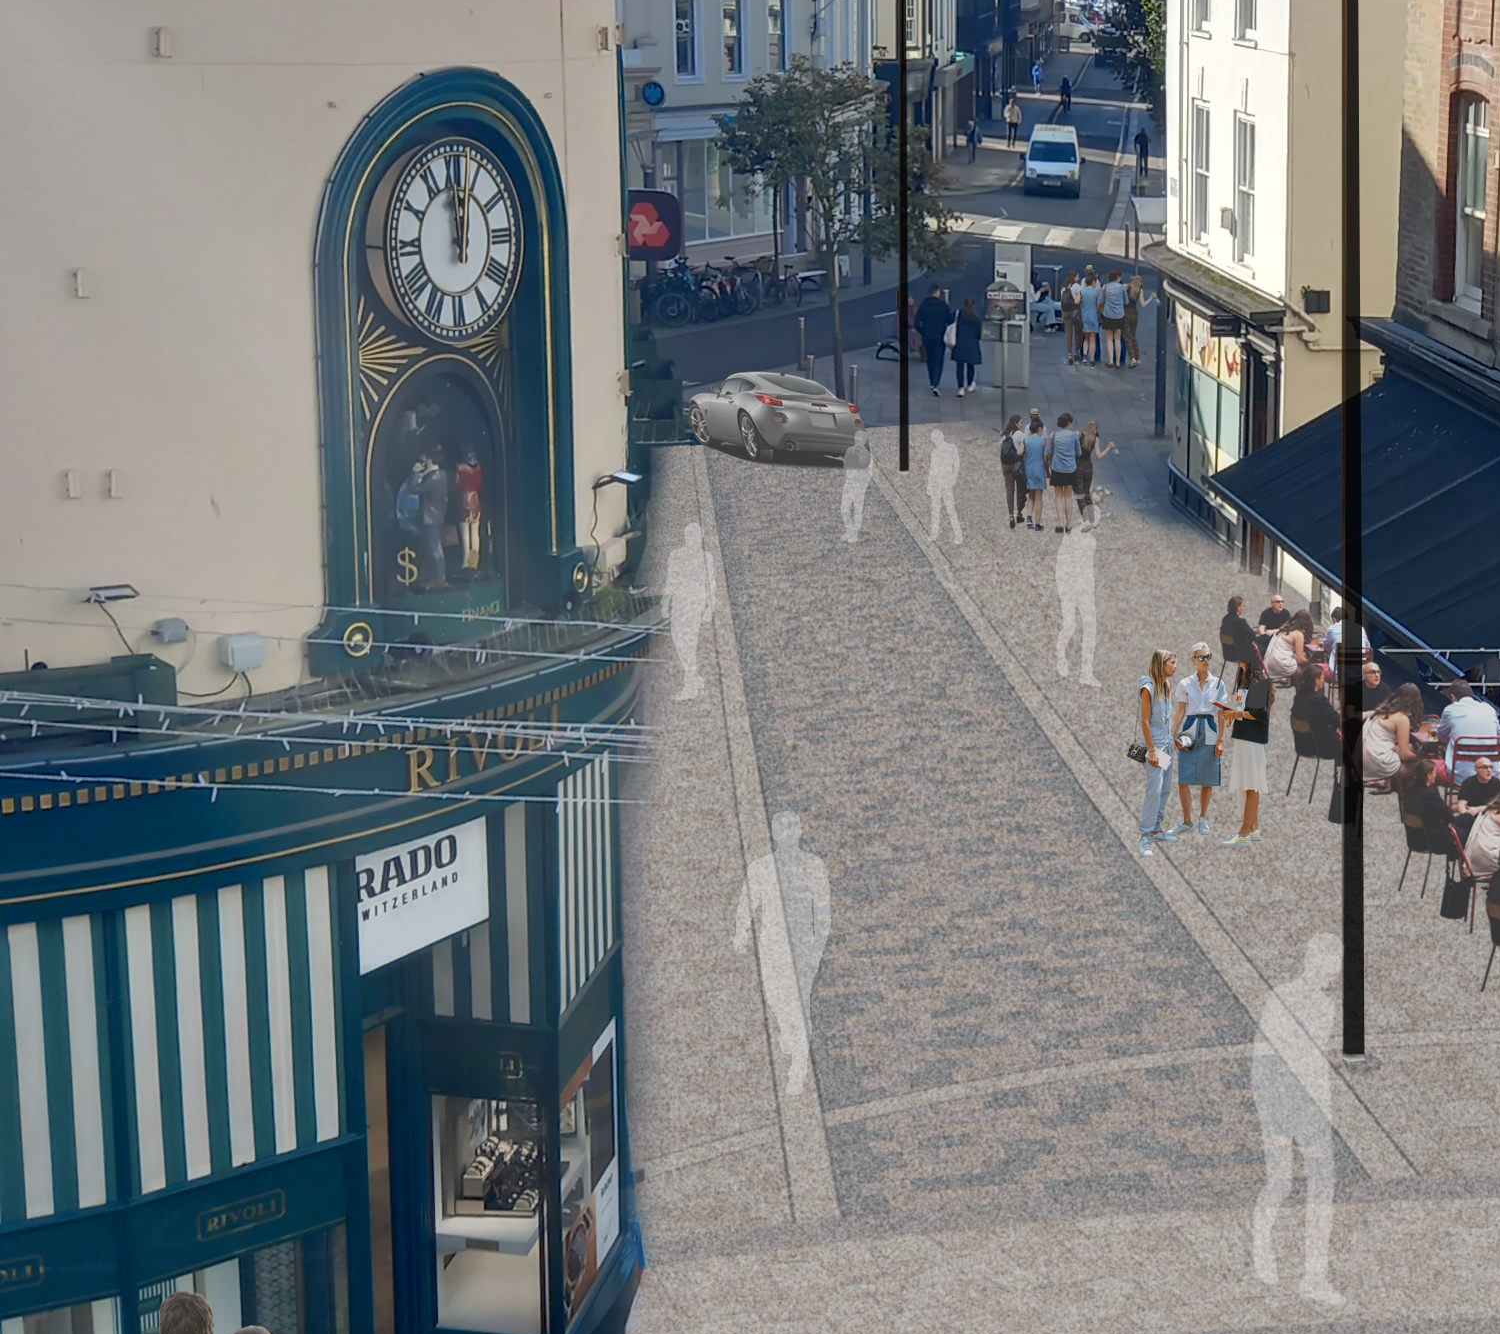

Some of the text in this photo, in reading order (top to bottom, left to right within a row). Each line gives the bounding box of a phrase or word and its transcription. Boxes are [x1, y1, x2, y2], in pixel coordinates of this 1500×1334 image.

[419, 165, 440, 199] XI
[403, 199, 424, 221] X
[483, 192, 503, 214] II
[399, 239, 420, 257] IX
[491, 227, 511, 245] III
[404, 264, 431, 303] VIII
[474, 285, 490, 315] V
[424, 285, 445, 324] VII
[451, 295, 466, 326] VI
[405, 703, 560, 793] RIVOLI
[357, 834, 458, 903] RADO
[362, 872, 459, 922] WITZERLAND
[208, 1199, 278, 1232] RIVOLI
